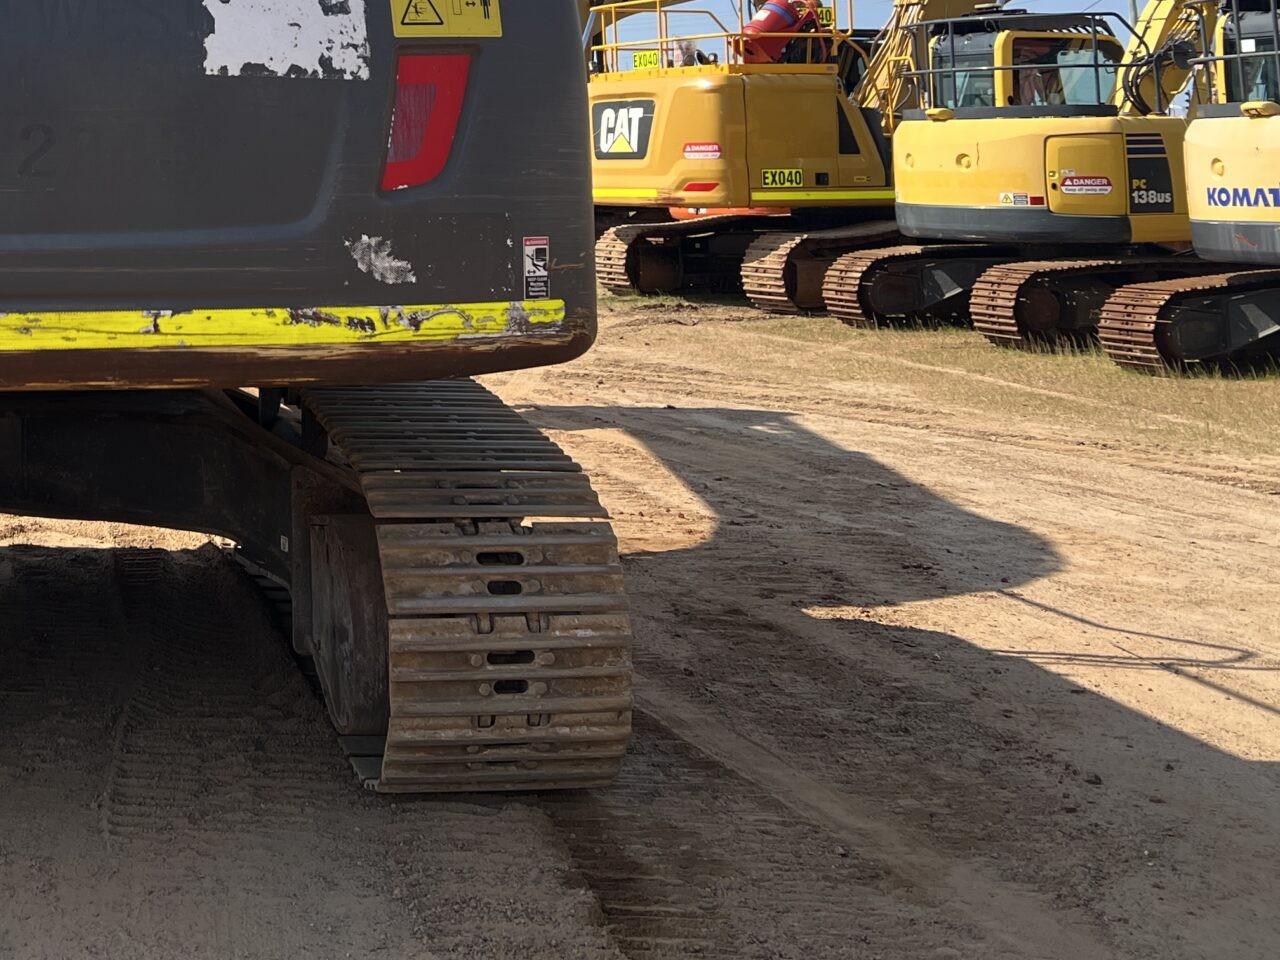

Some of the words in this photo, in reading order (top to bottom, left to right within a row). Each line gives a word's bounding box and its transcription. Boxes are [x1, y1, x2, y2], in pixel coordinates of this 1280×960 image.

[633, 52, 658, 68] EX040
[600, 107, 644, 153] CAT
[762, 170, 803, 186] EX040
[1073, 178, 1108, 186] DANGER
[1132, 179, 1147, 189] PC
